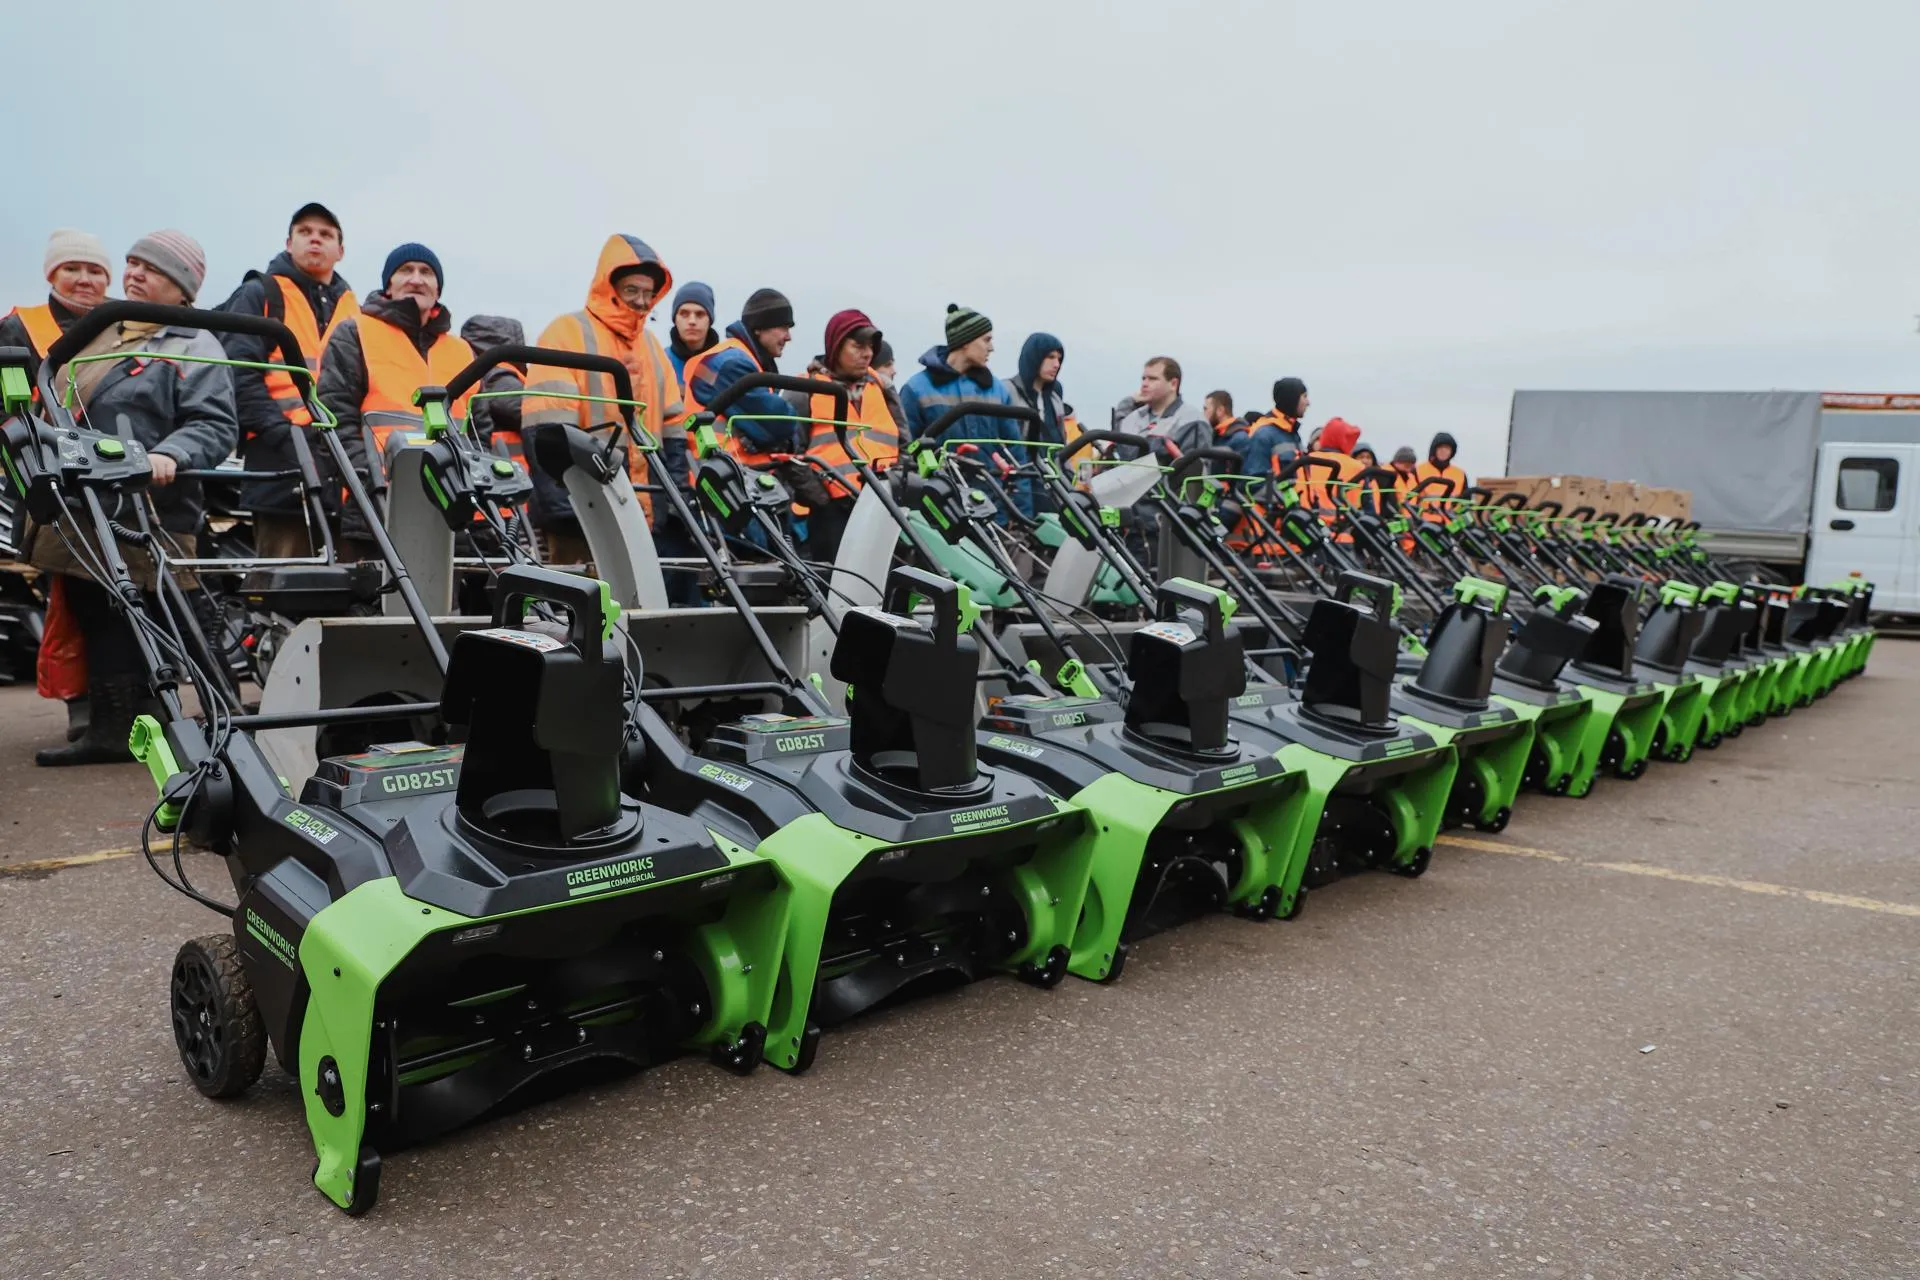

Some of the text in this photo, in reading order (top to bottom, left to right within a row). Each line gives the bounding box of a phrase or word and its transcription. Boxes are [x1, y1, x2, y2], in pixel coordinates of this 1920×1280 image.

[776, 733, 825, 752] GD82ST
[382, 768, 455, 793] GD82ST
[698, 763, 749, 785] 82 VOLT
[284, 809, 334, 836] 82 VOLT
[950, 805, 1009, 824] GREENWORKS
[566, 856, 655, 886] GREENWORKS
[610, 871, 656, 888] COMMERCIAL
[246, 907, 296, 960] GREENWORKS
